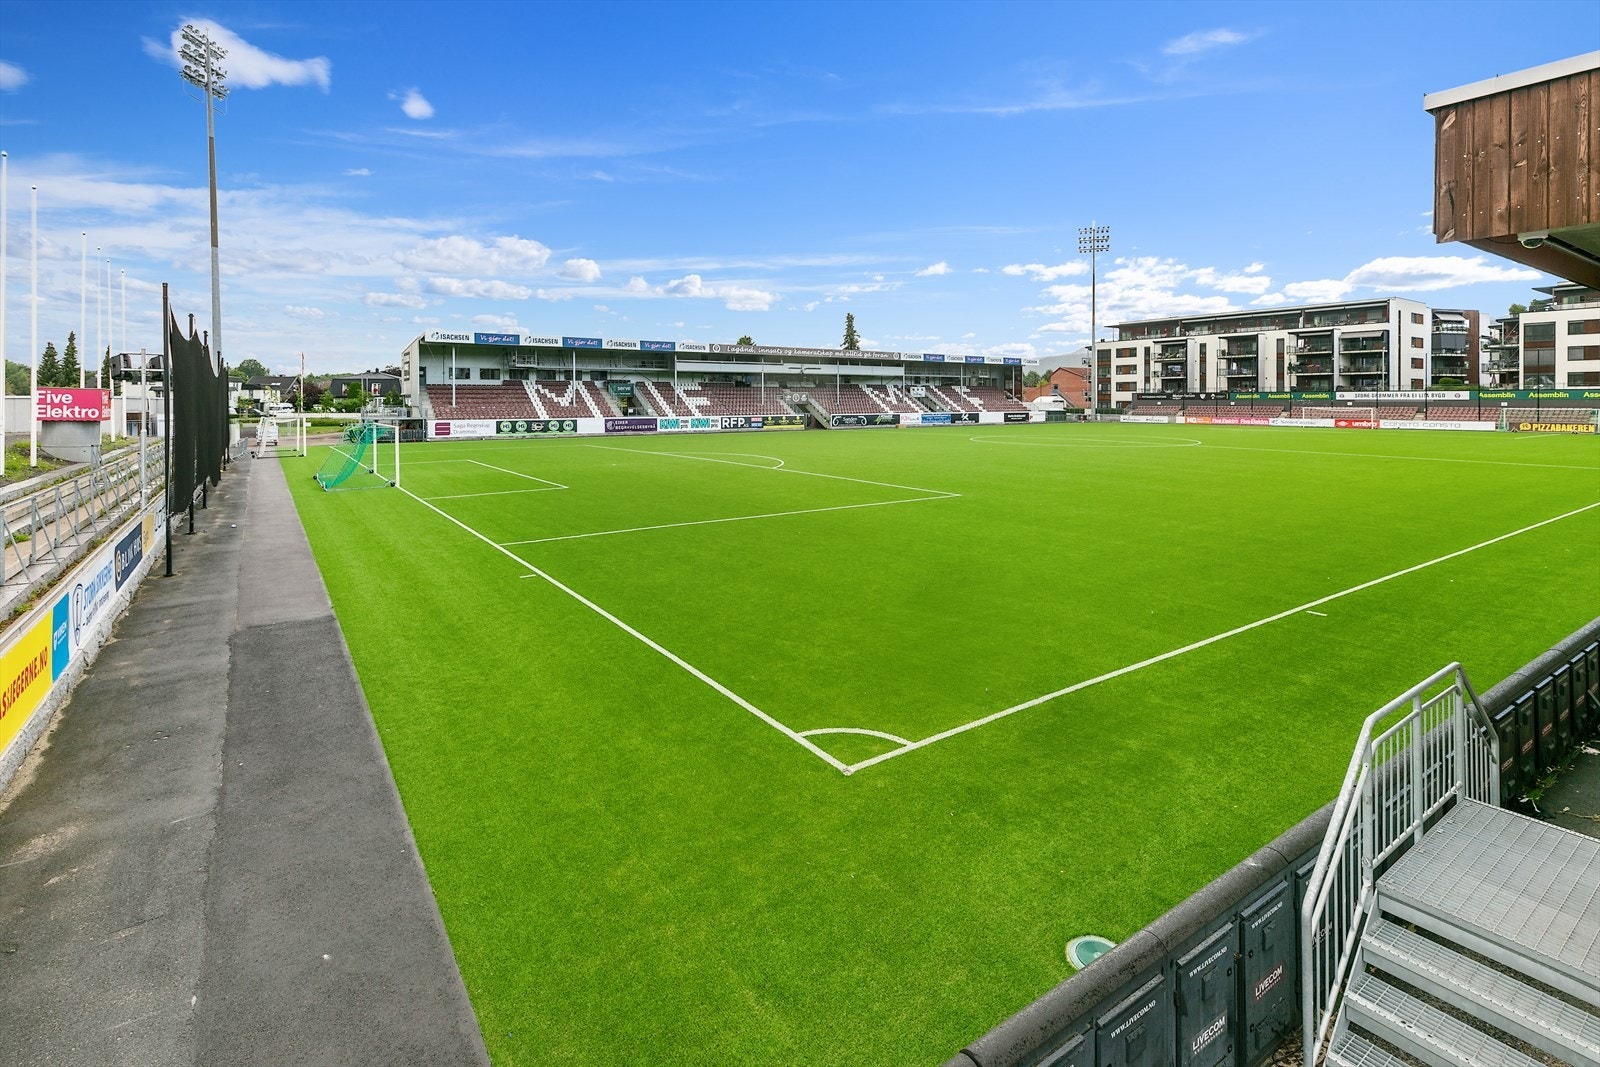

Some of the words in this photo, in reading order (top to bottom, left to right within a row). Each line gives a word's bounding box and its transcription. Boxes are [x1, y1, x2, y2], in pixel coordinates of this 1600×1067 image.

[440, 333, 470, 341] ISACHSEN
[532, 336, 559, 345] ISACHSEN
[37, 390, 73, 404] Five
[37, 405, 100, 418] Elektro
[722, 418, 745, 428] RFP
[1255, 965, 1284, 997] LIVECOM
[1109, 999, 1156, 1039] WWW.LIVECOM.NO
[1192, 1015, 1226, 1051] LIVECOM
